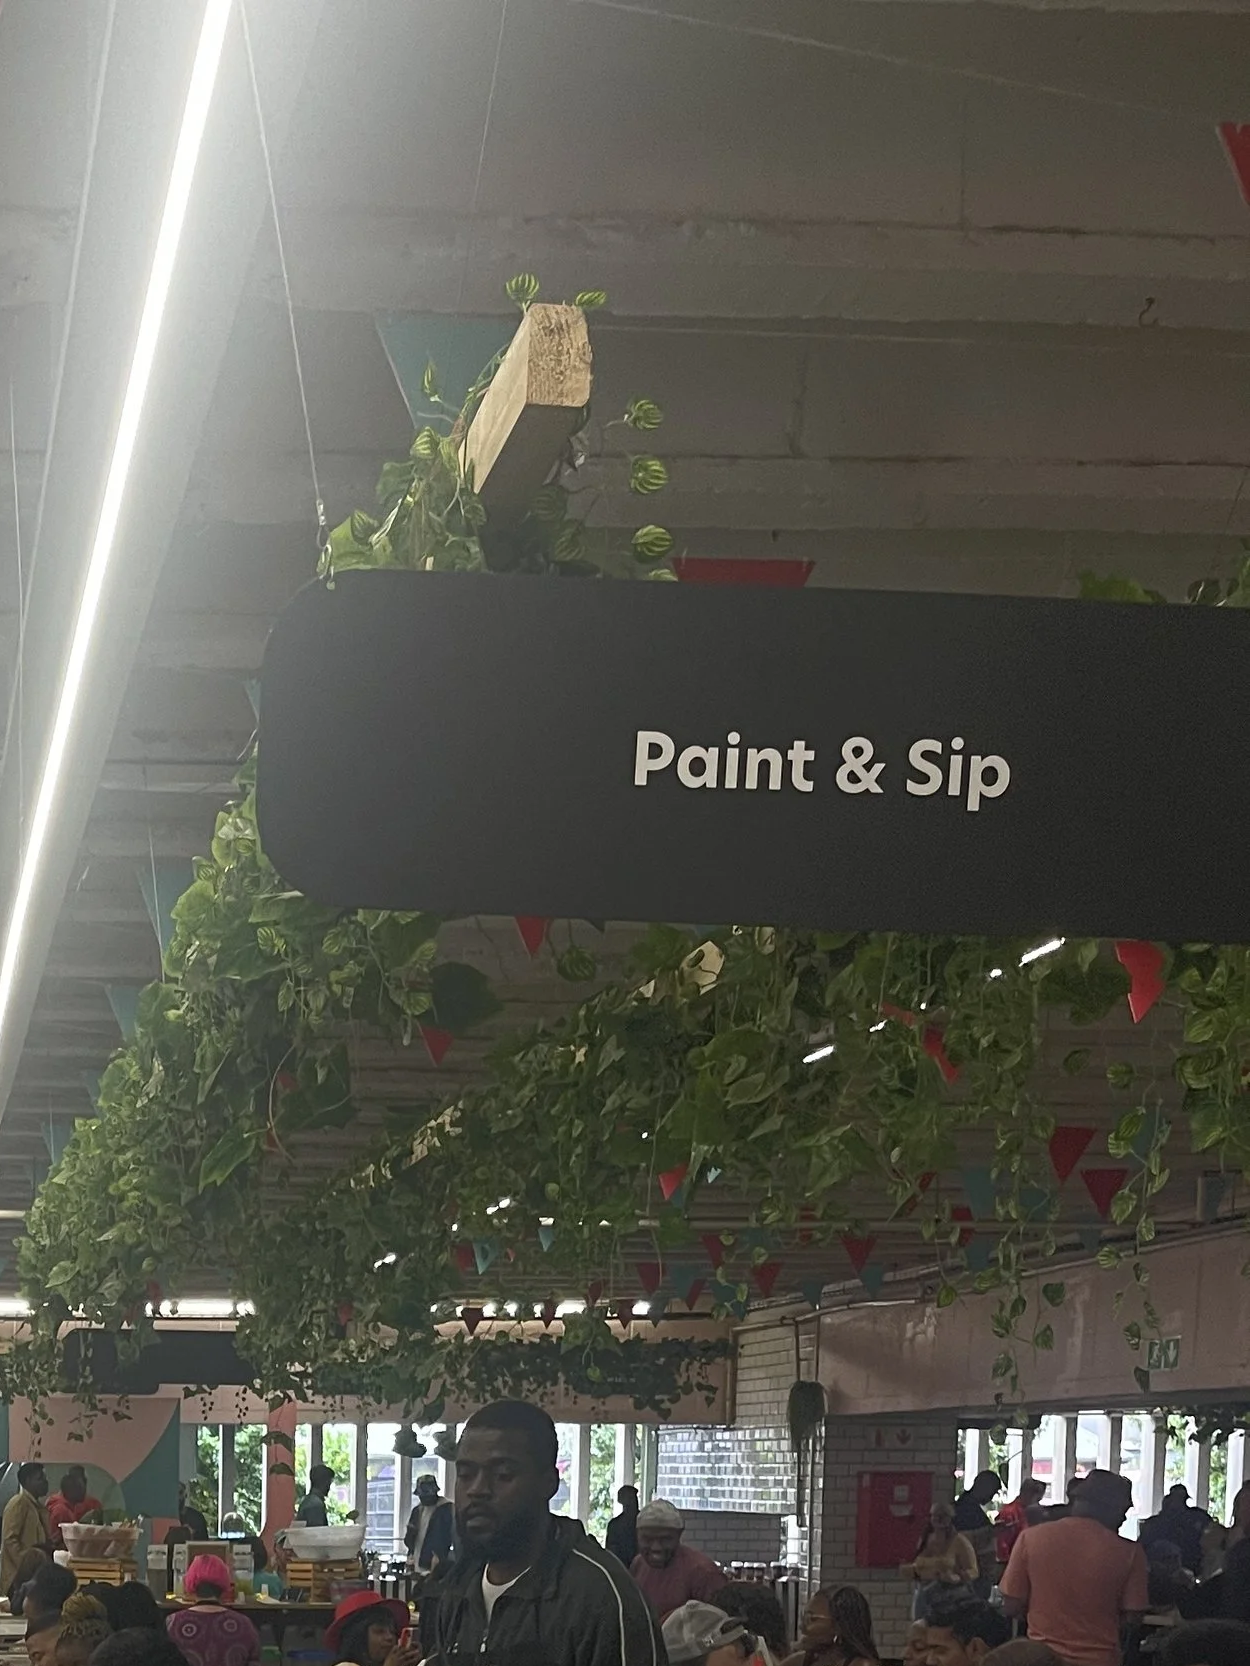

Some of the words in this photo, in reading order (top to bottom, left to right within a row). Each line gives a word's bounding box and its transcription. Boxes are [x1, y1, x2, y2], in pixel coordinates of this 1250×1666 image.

[634, 730, 816, 792] Paint
[835, 736, 887, 795] &
[905, 736, 1012, 812] Sip
